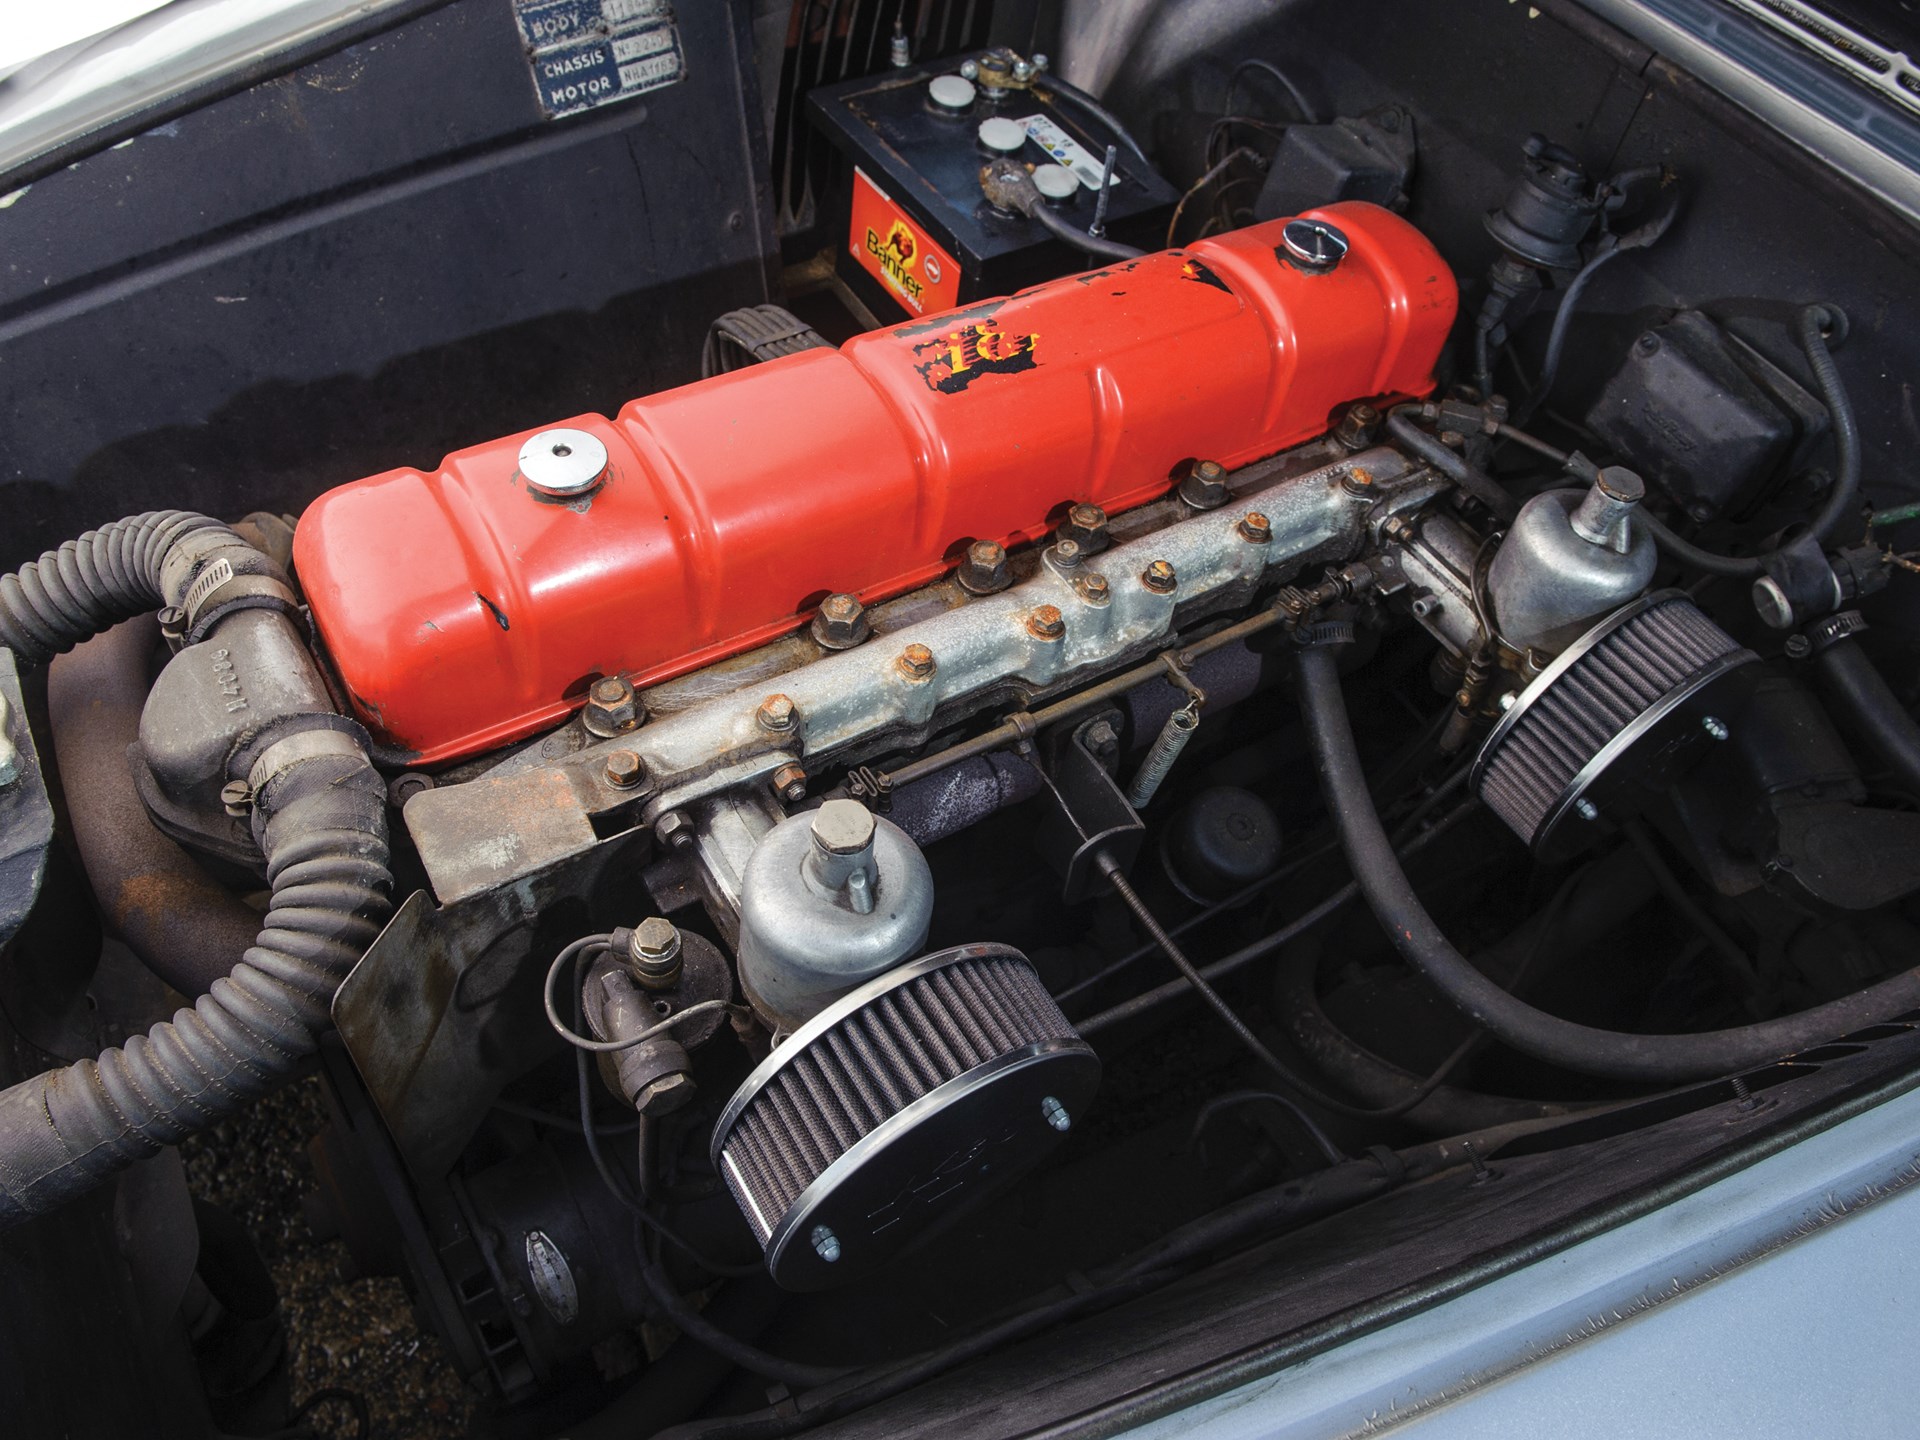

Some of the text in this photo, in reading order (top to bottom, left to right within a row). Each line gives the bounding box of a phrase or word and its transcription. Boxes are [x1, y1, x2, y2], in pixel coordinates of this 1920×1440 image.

[531, 11, 580, 39] BODY
[544, 50, 605, 79] CHASSIS
[551, 76, 612, 105] MOTOR
[866, 228, 924, 298] Banner
